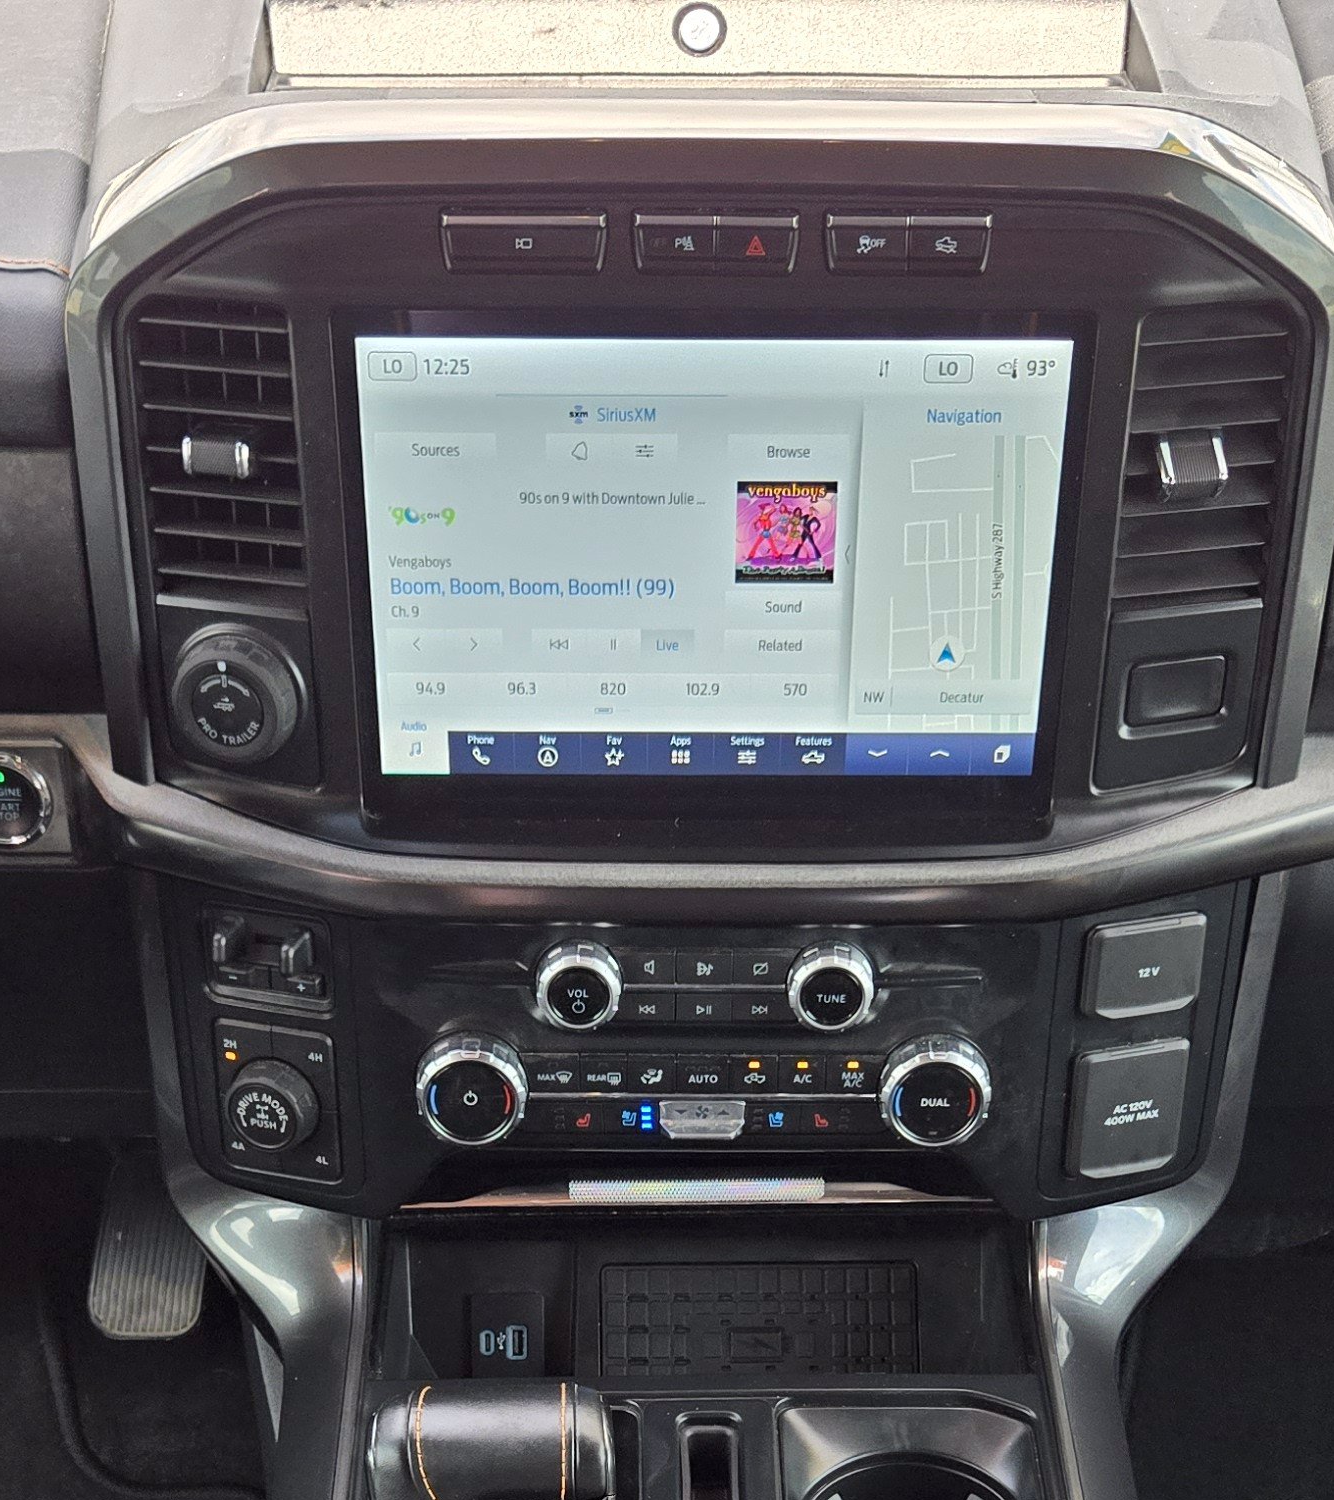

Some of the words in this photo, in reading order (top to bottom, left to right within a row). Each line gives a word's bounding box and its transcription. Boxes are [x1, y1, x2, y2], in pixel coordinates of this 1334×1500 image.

[871, 238, 887, 248] OFF
[382, 358, 403, 374] LO
[422, 358, 470, 376] 12:25
[938, 360, 959, 377] LO
[597, 407, 657, 422] SiriusXM
[926, 409, 1002, 425] Navigation
[411, 443, 461, 457] Sources
[766, 445, 811, 459] Browse
[518, 491, 543, 506] 90s
[544, 494, 559, 505] on
[561, 491, 570, 506] 9
[571, 491, 599, 505] with
[601, 492, 666, 505] Downtown
[667, 492, 694, 506] Julie
[992, 523, 1003, 542] 287
[388, 555, 452, 570] Vengaboys
[992, 545, 1004, 590] Highway
[390, 578, 445, 597] Boom,
[449, 578, 505, 597] Boom,
[509, 578, 564, 598] Boom,
[568, 578, 631, 597] Boom!!
[636, 578, 675, 599] (99)
[991, 591, 1002, 599] S
[765, 601, 802, 613] Sound
[656, 639, 679, 651] Live
[758, 639, 803, 652] Related
[415, 682, 446, 696] 94.9
[507, 682, 537, 696] 96.3
[600, 682, 627, 696] 820
[686, 683, 720, 697] 102.9
[783, 683, 808, 697] 570
[863, 691, 885, 703] NW
[939, 691, 984, 703] Decatur
[197, 717, 219, 739] PRO
[222, 721, 260, 745] TRAILER
[400, 721, 427, 732] Audio
[467, 735, 495, 746] Phone
[539, 735, 557, 745] Nav
[605, 735, 623, 745] Fav
[670, 735, 692, 747] Apps
[730, 735, 765, 748] Settings
[795, 736, 832, 747] Features
[567, 988, 589, 998] VOL
[816, 993, 847, 1004] TUNE
[223, 1039, 238, 1050] 2H
[307, 1051, 323, 1063] 4H
[537, 1073, 555, 1082] MAX
[587, 1073, 607, 1083] REAR
[688, 1074, 718, 1084] AUTO
[793, 1074, 813, 1084] A/C
[841, 1071, 865, 1081] MAX
[842, 1079, 863, 1088] A/C
[236, 1092, 260, 1115] DRIVE
[261, 1093, 289, 1121] MODE
[920, 1097, 951, 1107] DUAL
[1112, 1103, 1128, 1115] AC
[1129, 1099, 1154, 1112] 120V
[250, 1117, 277, 1130] PUSH
[1103, 1113, 1136, 1126] 400W
[1136, 1109, 1159, 1121] MAX
[231, 1140, 246, 1151] 4A
[315, 1155, 329, 1165] 4L
